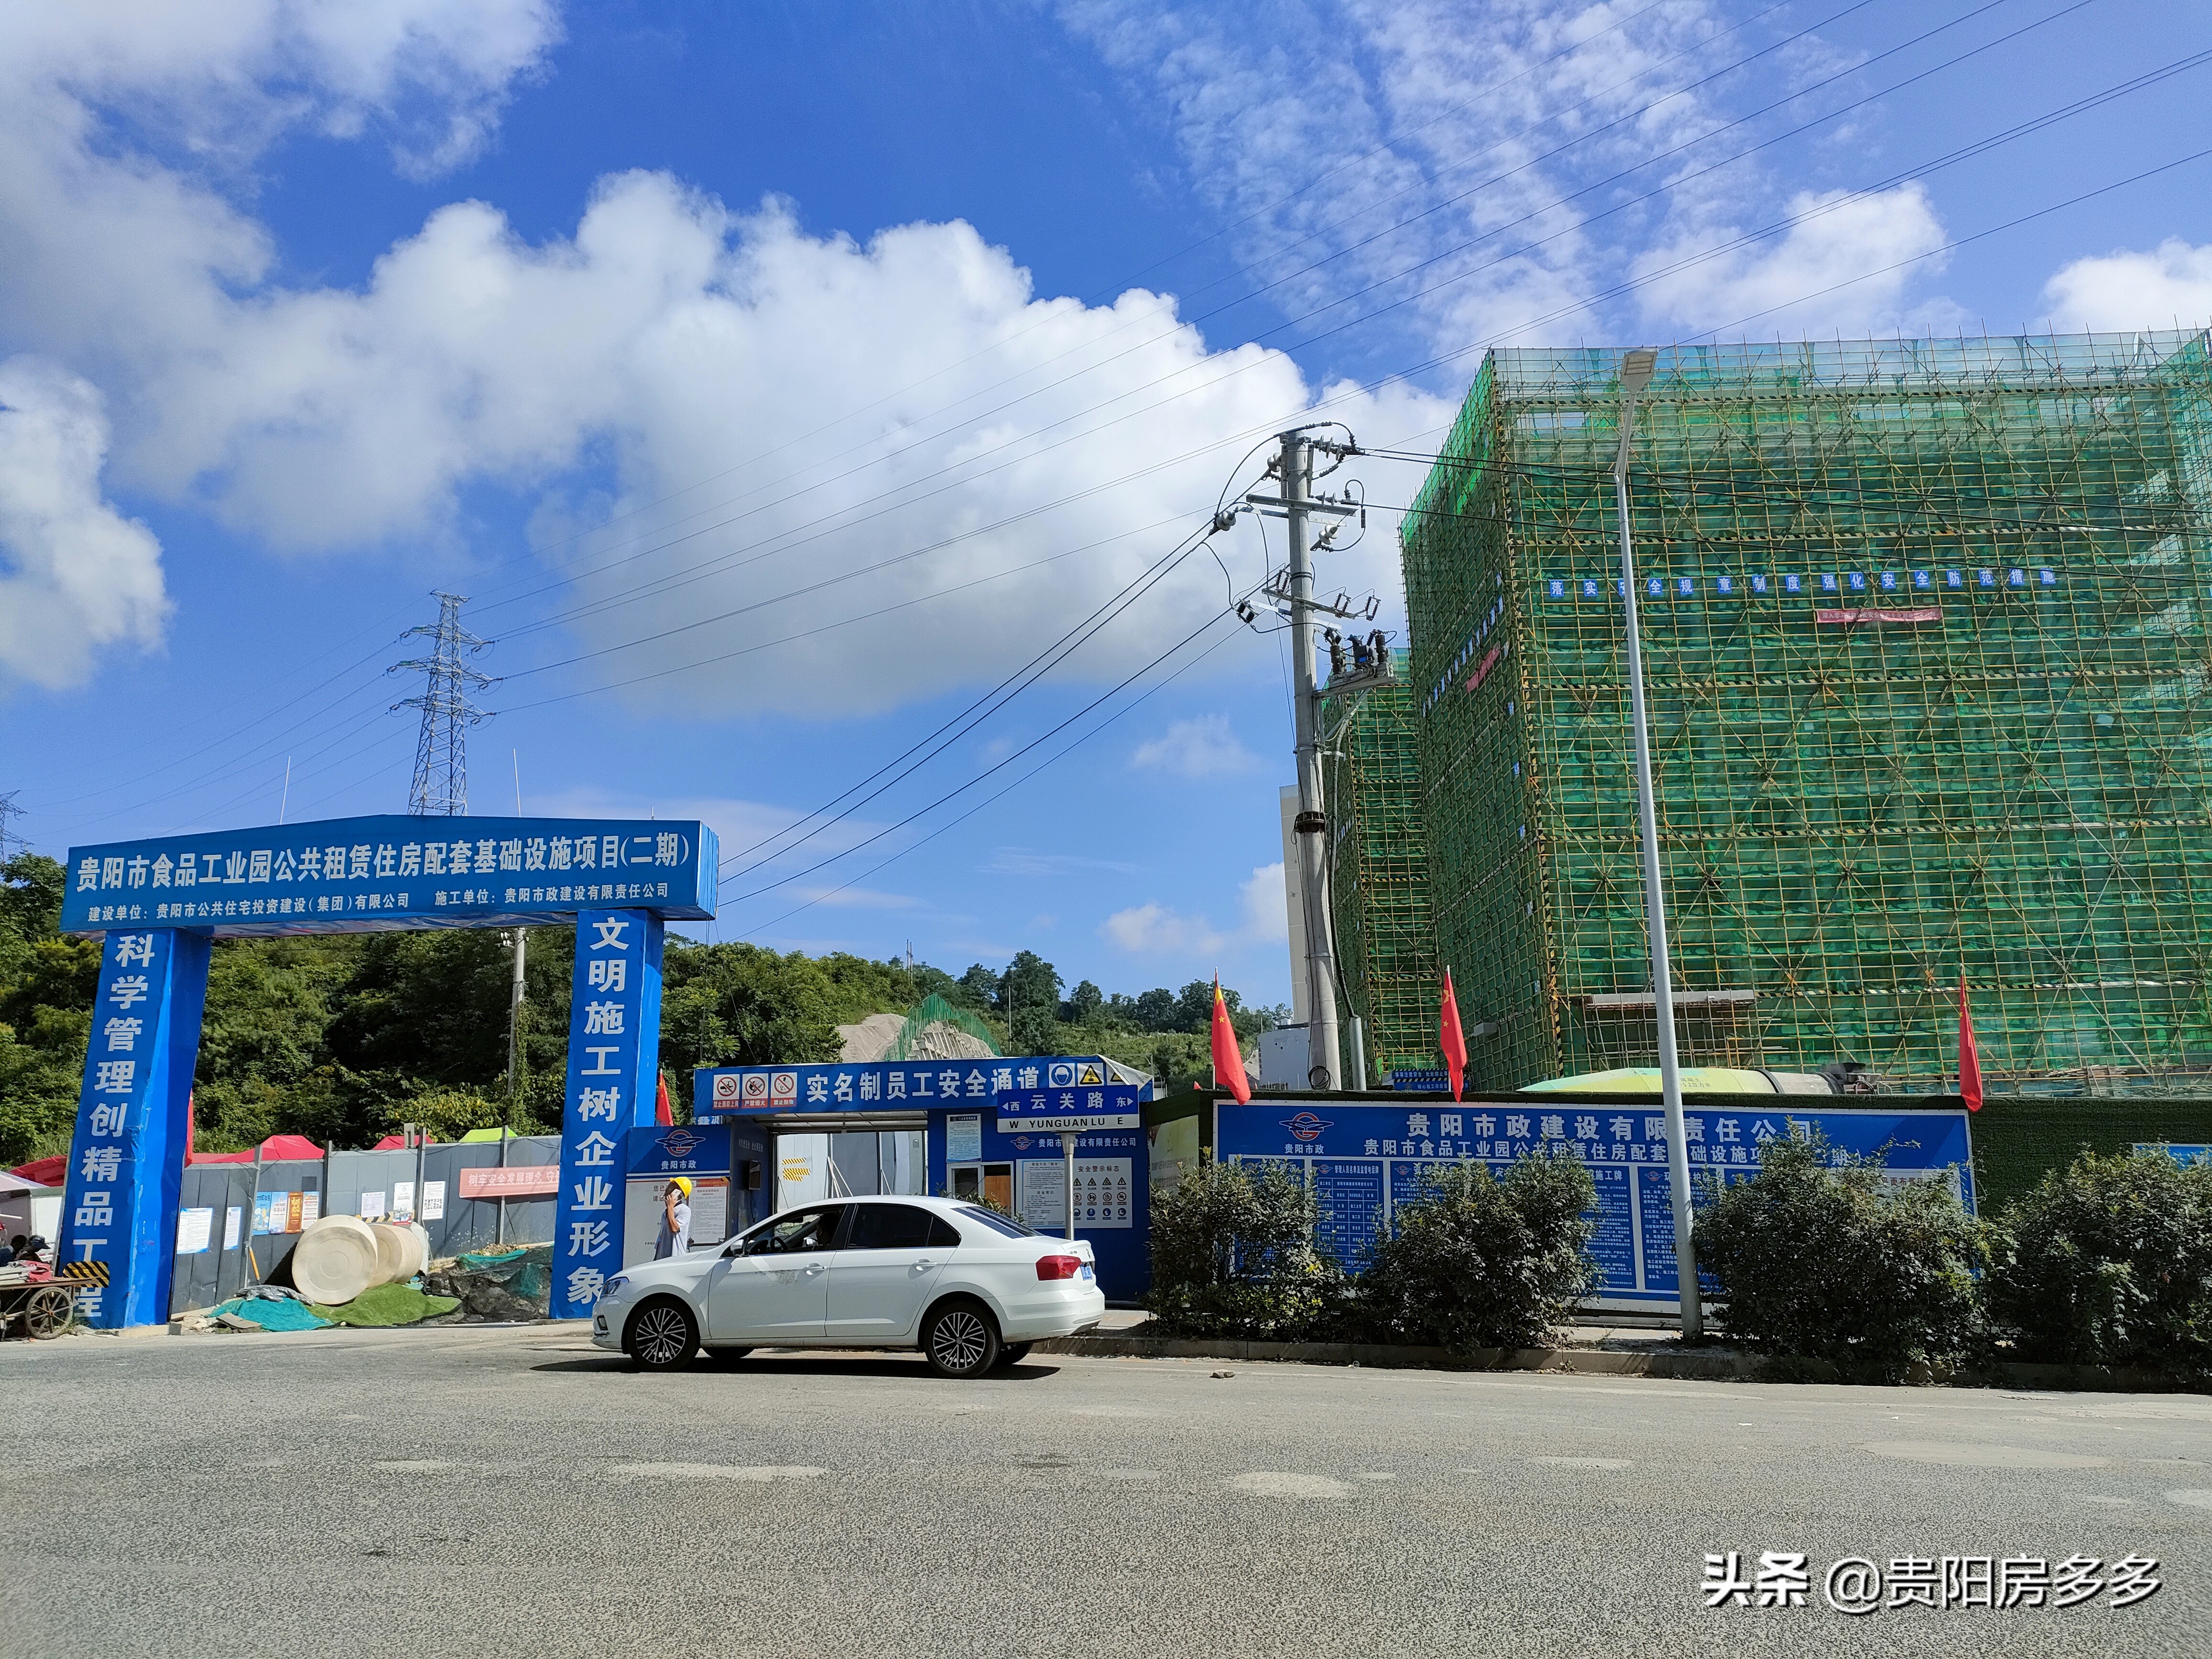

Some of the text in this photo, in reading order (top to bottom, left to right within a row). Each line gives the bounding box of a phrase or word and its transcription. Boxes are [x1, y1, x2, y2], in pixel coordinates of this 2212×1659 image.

[807, 1066, 1040, 1103] 实名制员工安全通道
[1009, 1091, 1126, 1111] 西 云关路 东
[567, 917, 630, 1305] 文明施工树企业形象
[1029, 1118, 1087, 1128] YUNGUAN
[1091, 1117, 1105, 1126] LU
[1406, 1112, 1811, 1144] 贵阳市政建设有限责任公司
[1038, 1137, 1136, 1148] 贵阳市建设有限责任公司
[1284, 1143, 1324, 1154] 贵阳市政
[661, 1160, 697, 1170] 贵阳市政
[468, 1172, 542, 1187] 树牢安全发展理念
